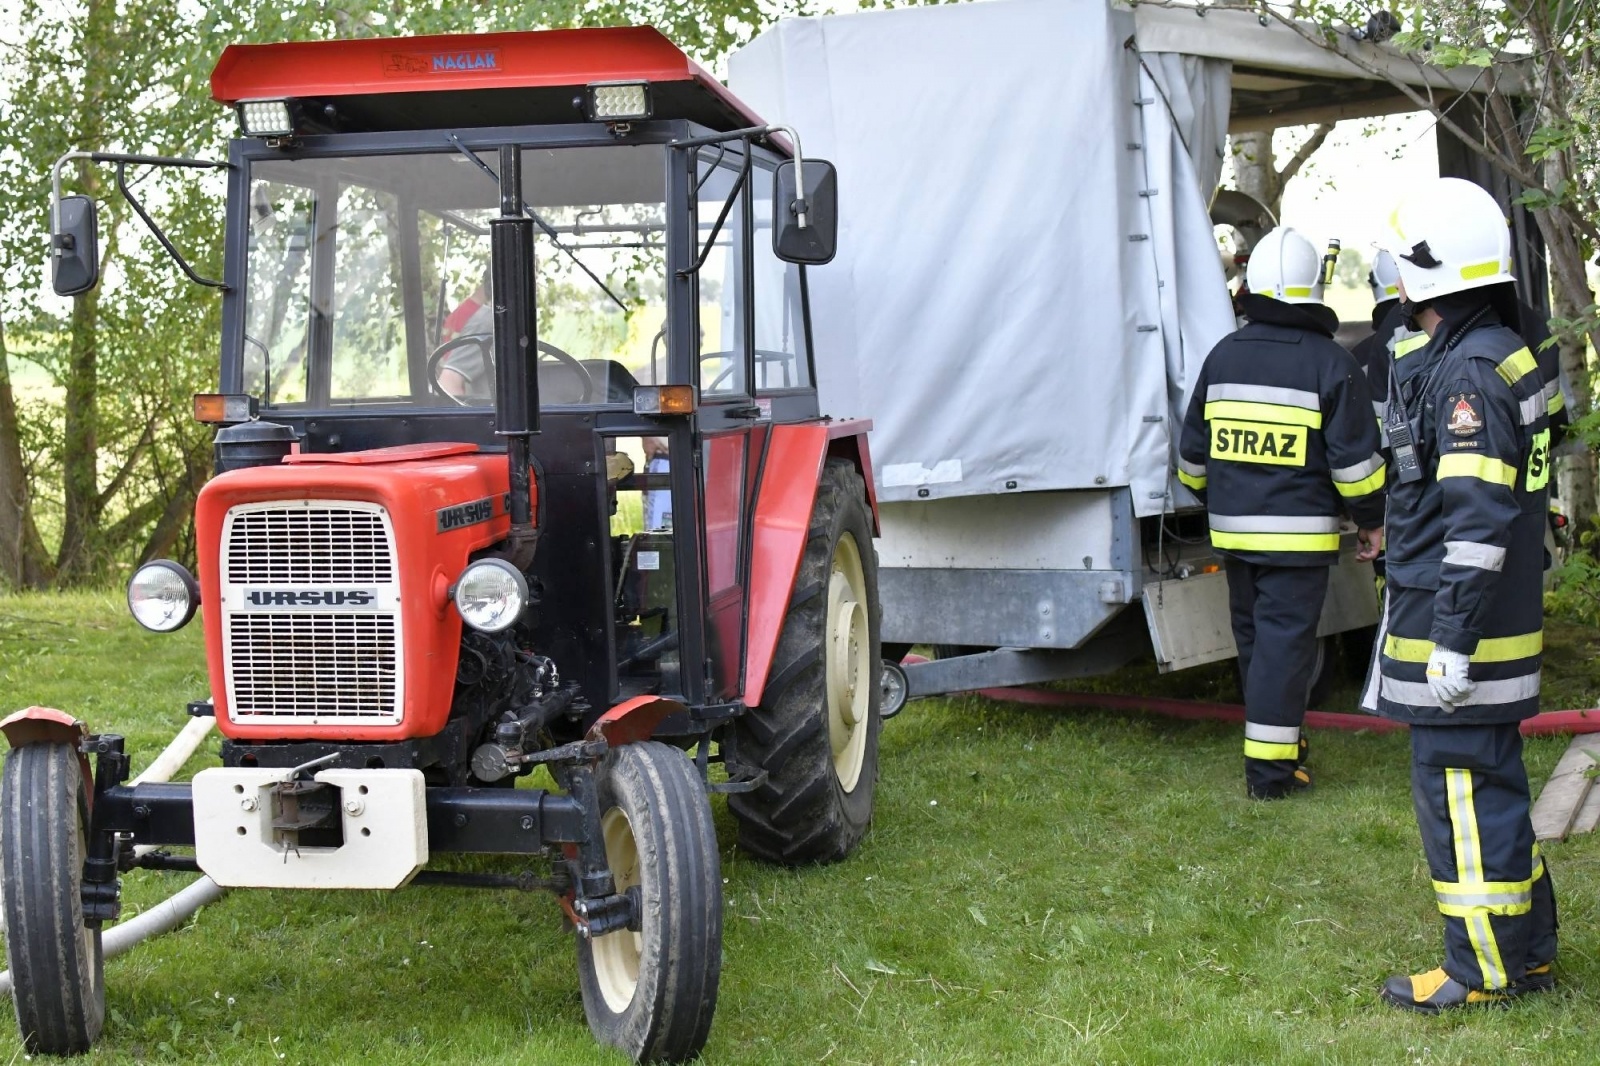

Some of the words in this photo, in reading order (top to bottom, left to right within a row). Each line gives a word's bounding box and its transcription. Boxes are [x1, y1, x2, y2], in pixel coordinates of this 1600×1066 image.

[432, 52, 496, 70] NAGLAK
[440, 501, 492, 529] URSUS
[247, 590, 375, 606] URSUS
